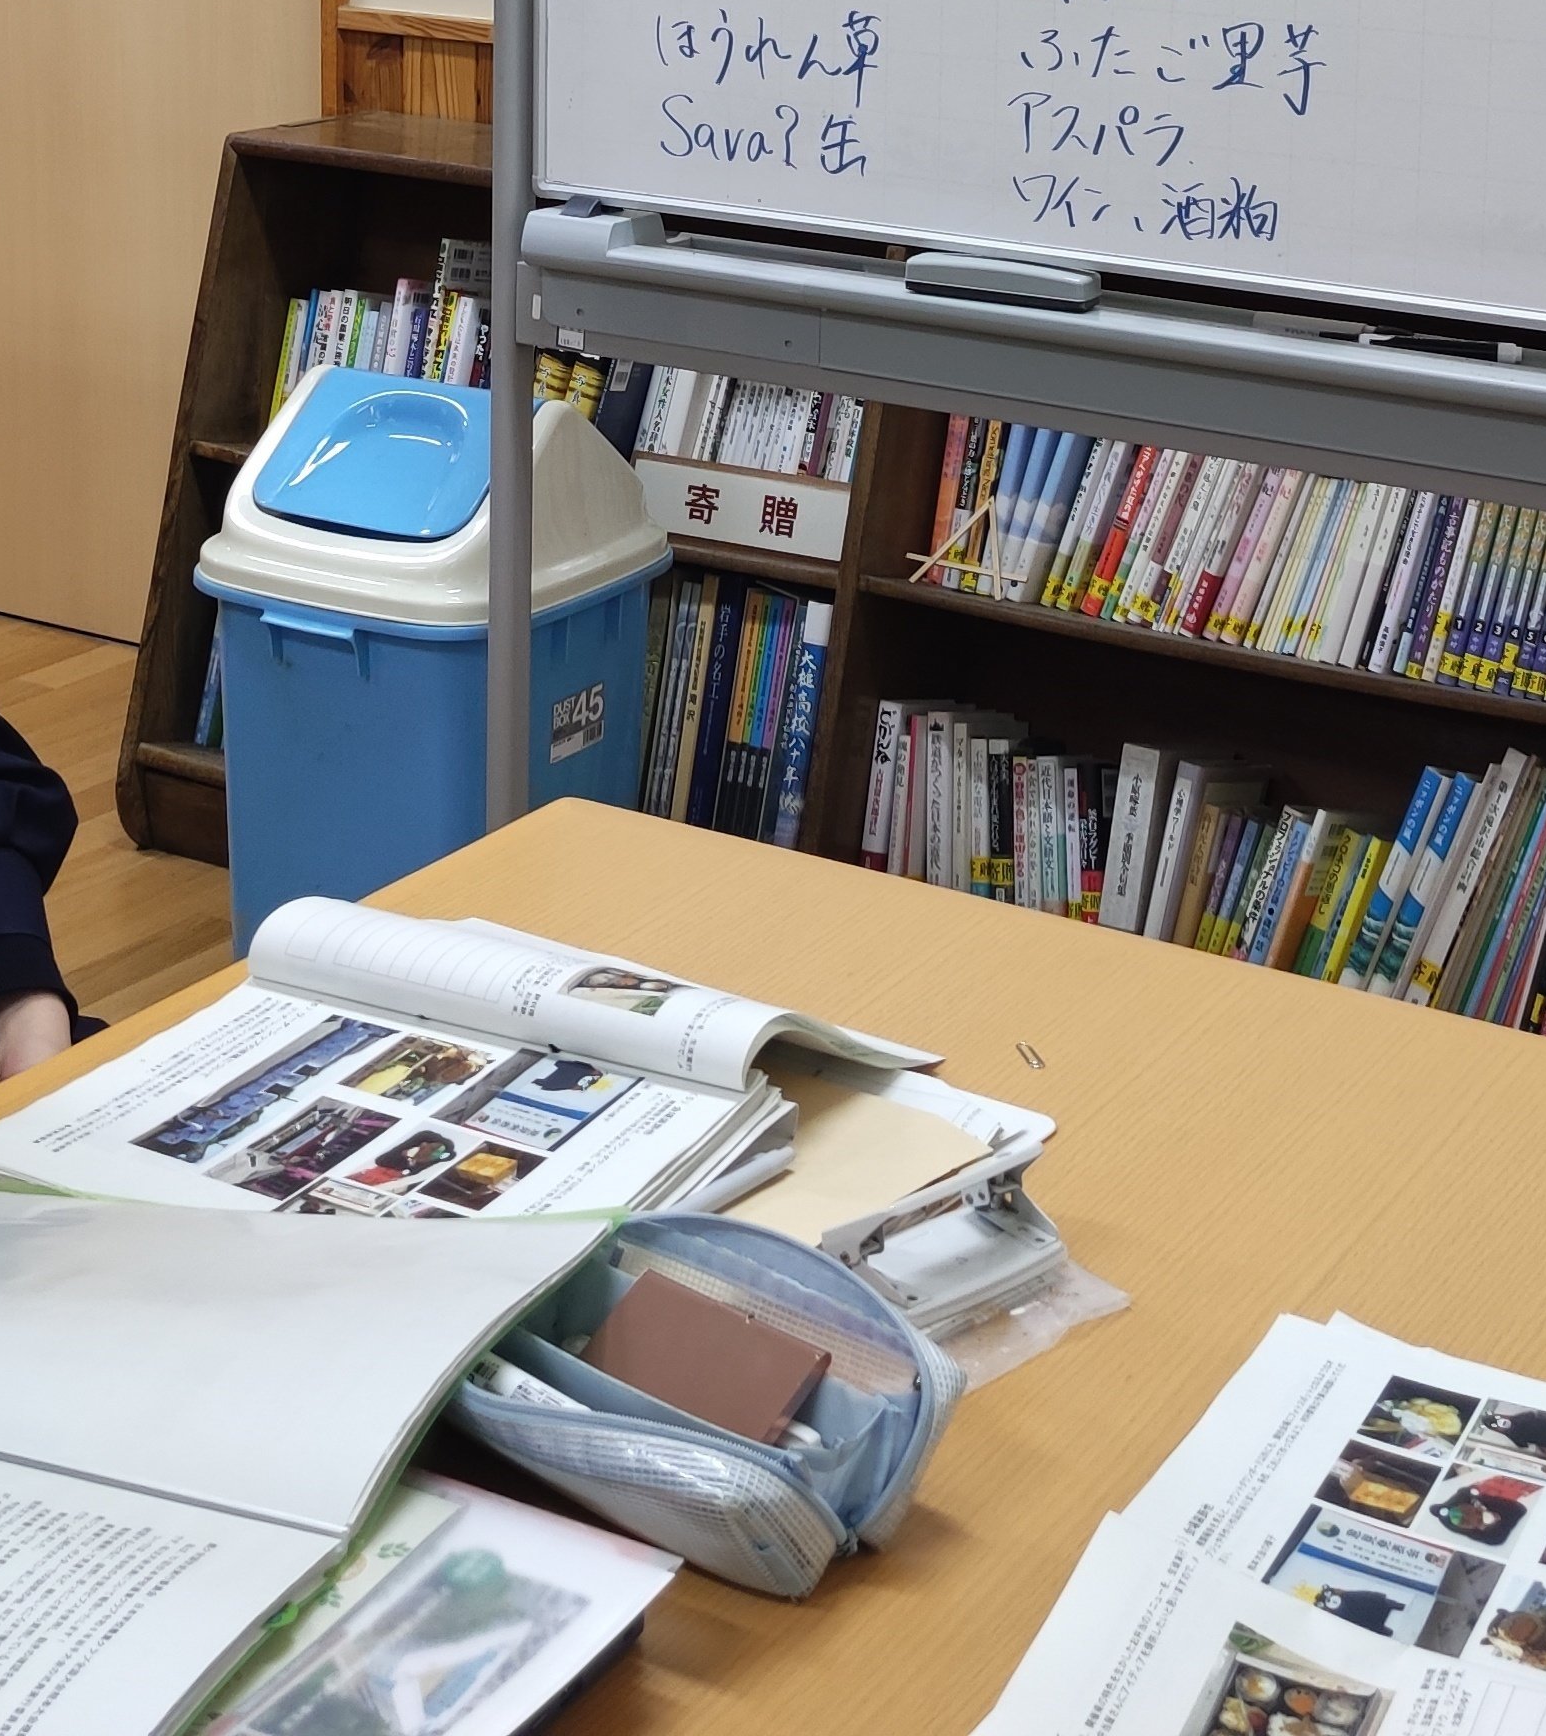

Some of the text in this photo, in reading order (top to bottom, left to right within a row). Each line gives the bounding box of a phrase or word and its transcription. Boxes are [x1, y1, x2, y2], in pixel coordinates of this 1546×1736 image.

[655, 8, 883, 107] ほうれん草
[1019, 21, 1329, 117] ふたご里芋
[684, 483, 798, 539] 寄贈
[708, 602, 732, 700] 岩手の名工
[554, 682, 604, 726] DUST 45
[554, 713, 570, 730] BOX
